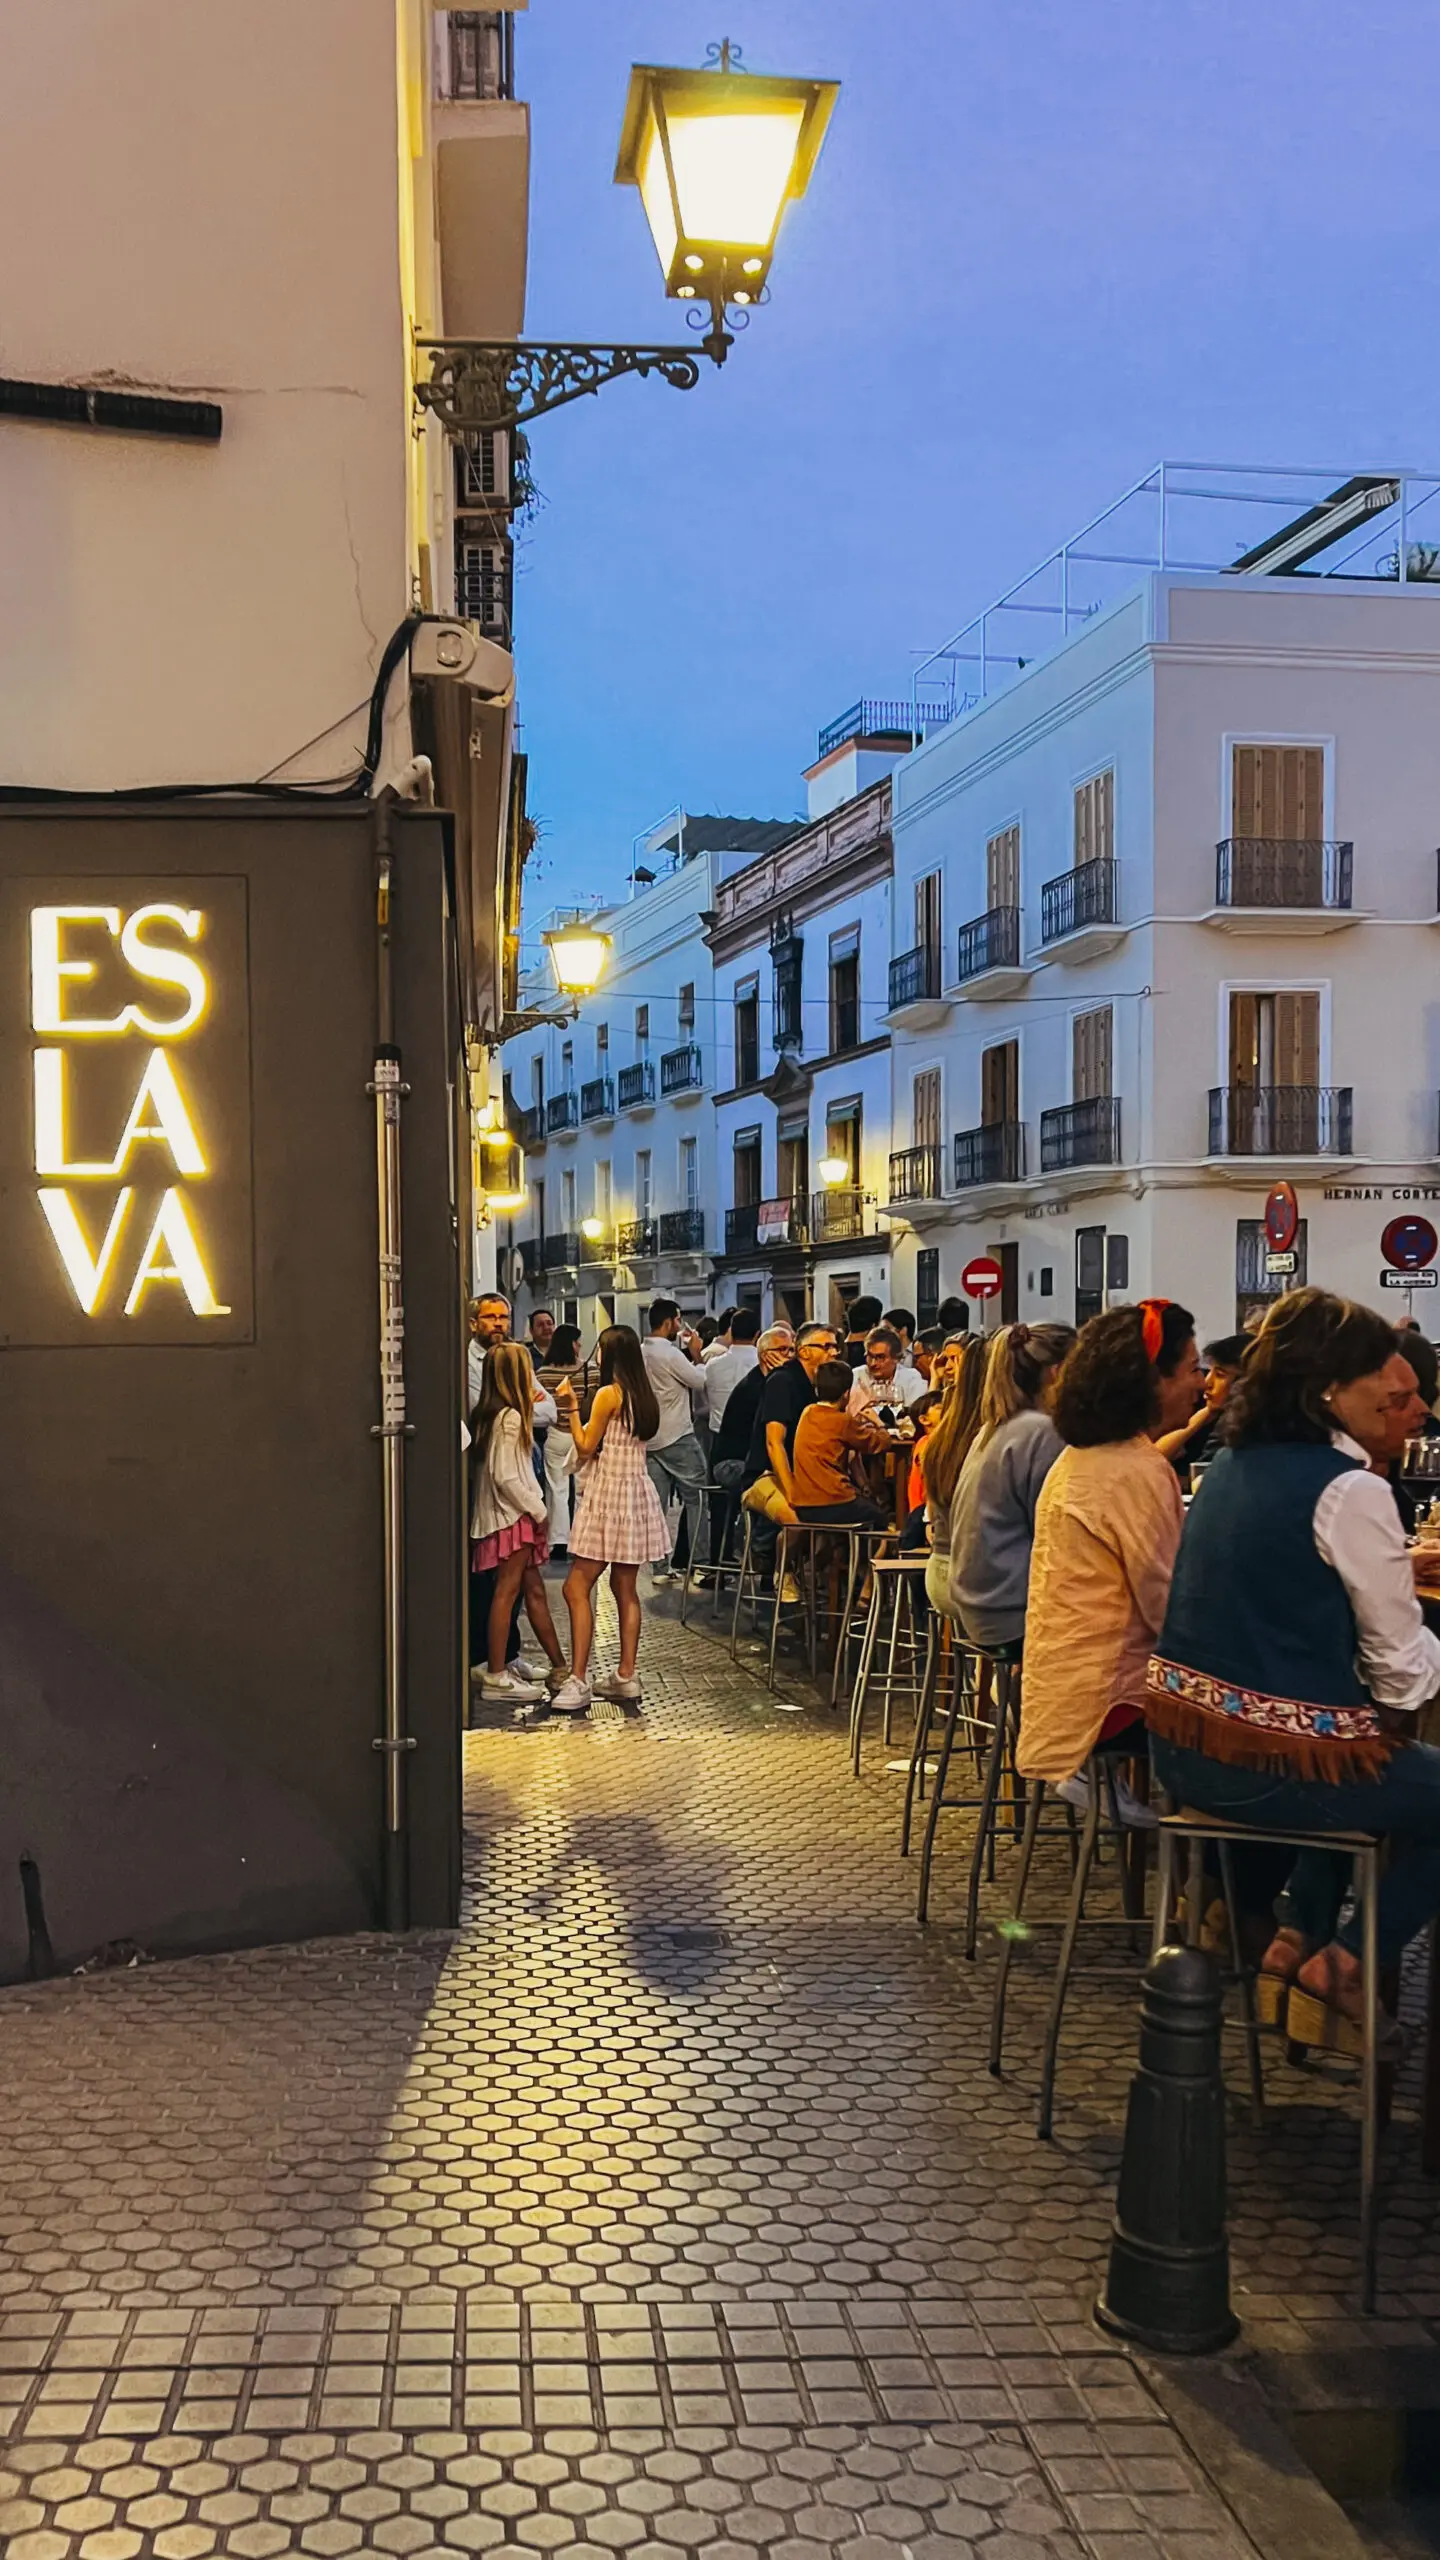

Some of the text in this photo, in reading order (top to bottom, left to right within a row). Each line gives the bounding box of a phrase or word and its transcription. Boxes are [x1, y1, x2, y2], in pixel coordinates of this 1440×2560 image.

[31, 904, 208, 1036] ES
[33, 1047, 209, 1176] LA
[37, 1187, 231, 1316] VA
